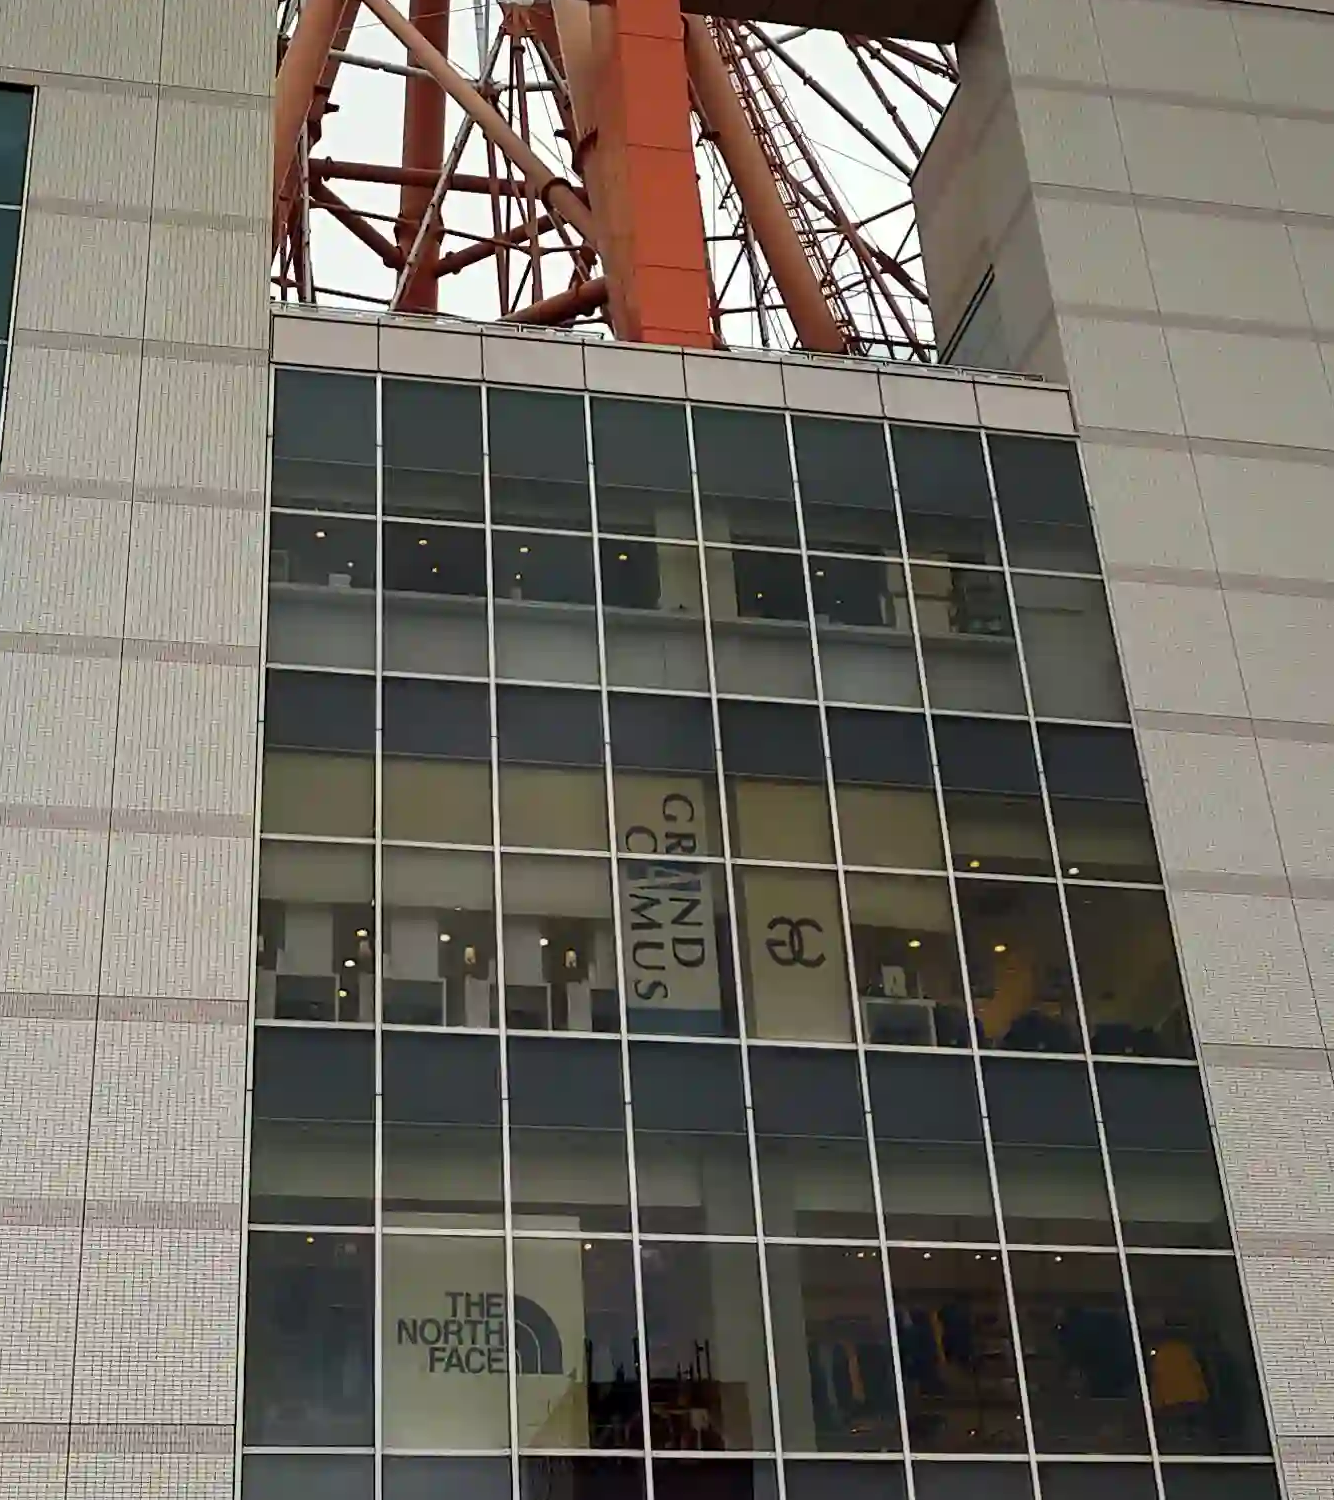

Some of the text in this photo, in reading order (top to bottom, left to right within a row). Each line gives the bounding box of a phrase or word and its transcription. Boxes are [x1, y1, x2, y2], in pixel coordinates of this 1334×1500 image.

[662, 793, 705, 968] GRAND
[445, 1291, 504, 1318] THE
[397, 1318, 507, 1345] NORTH
[428, 1346, 509, 1375] FACE
